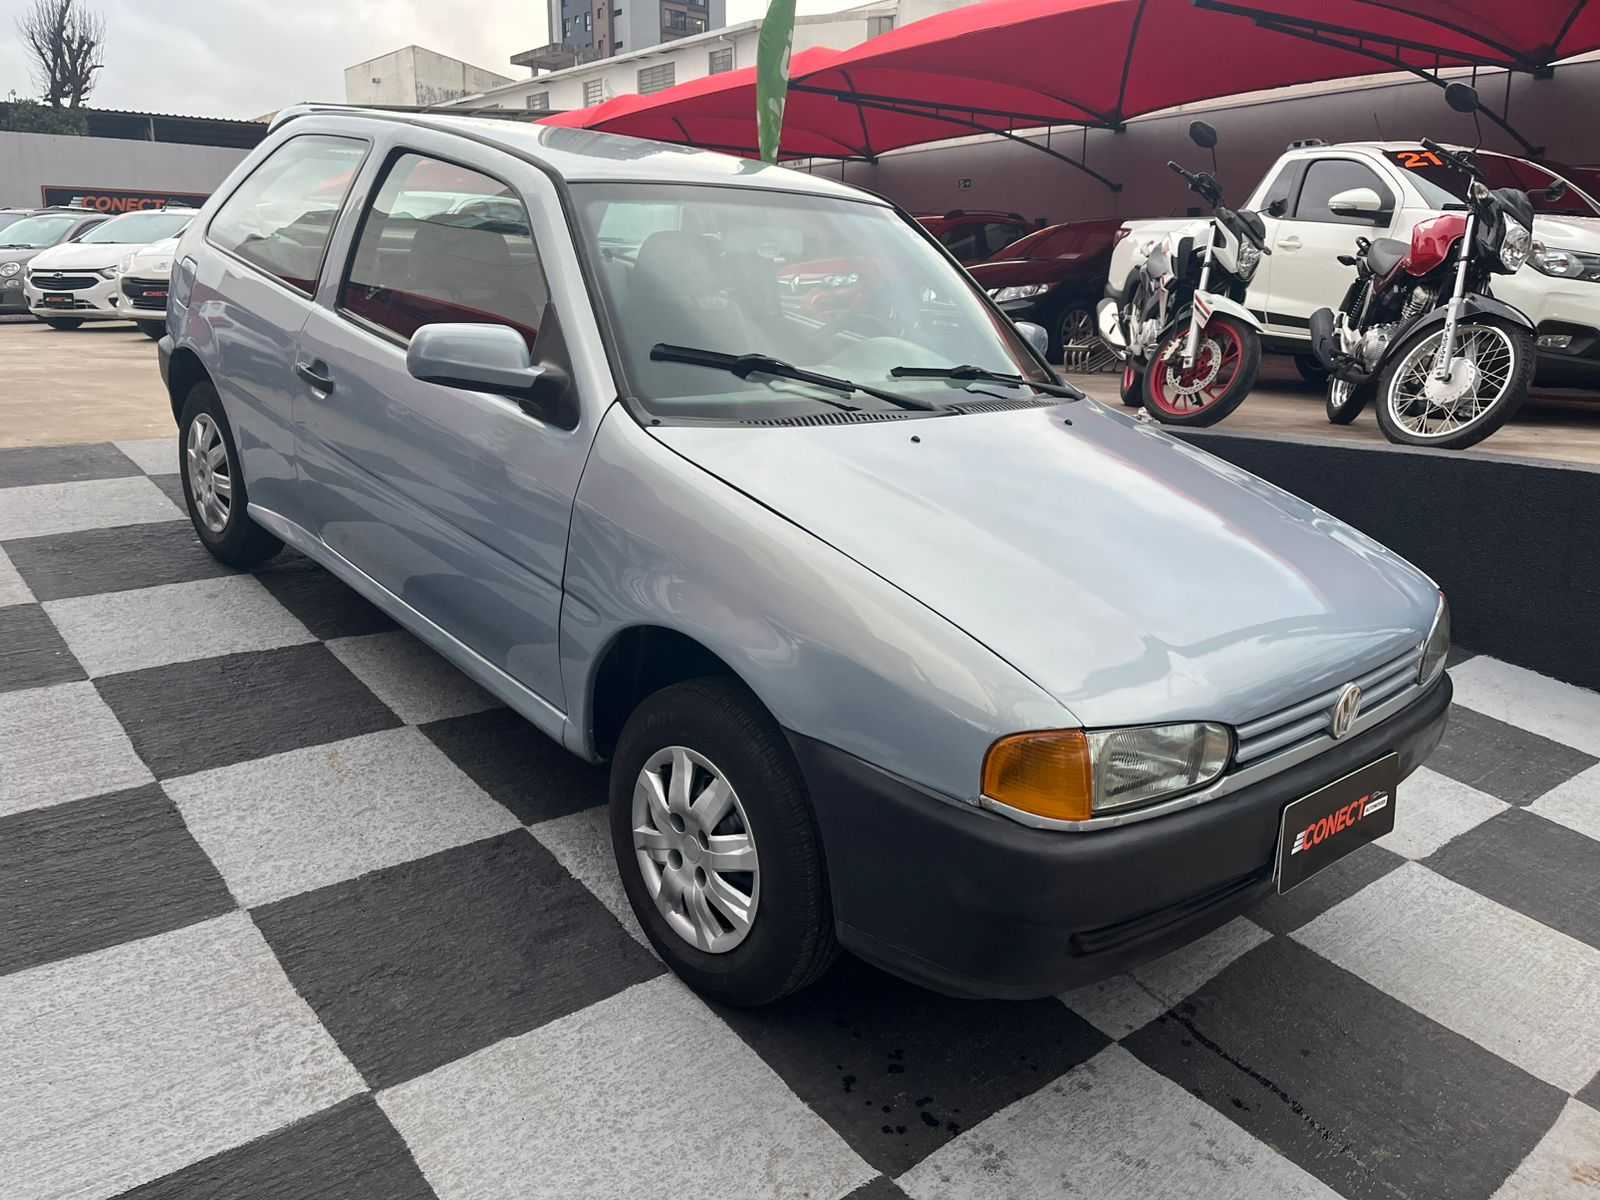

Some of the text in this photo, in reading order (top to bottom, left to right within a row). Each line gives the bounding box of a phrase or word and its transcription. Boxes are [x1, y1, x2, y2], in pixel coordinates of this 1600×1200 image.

[1397, 151, 1443, 168] 21
[82, 195, 166, 213] CONECT
[1303, 795, 1369, 850] CONECT
